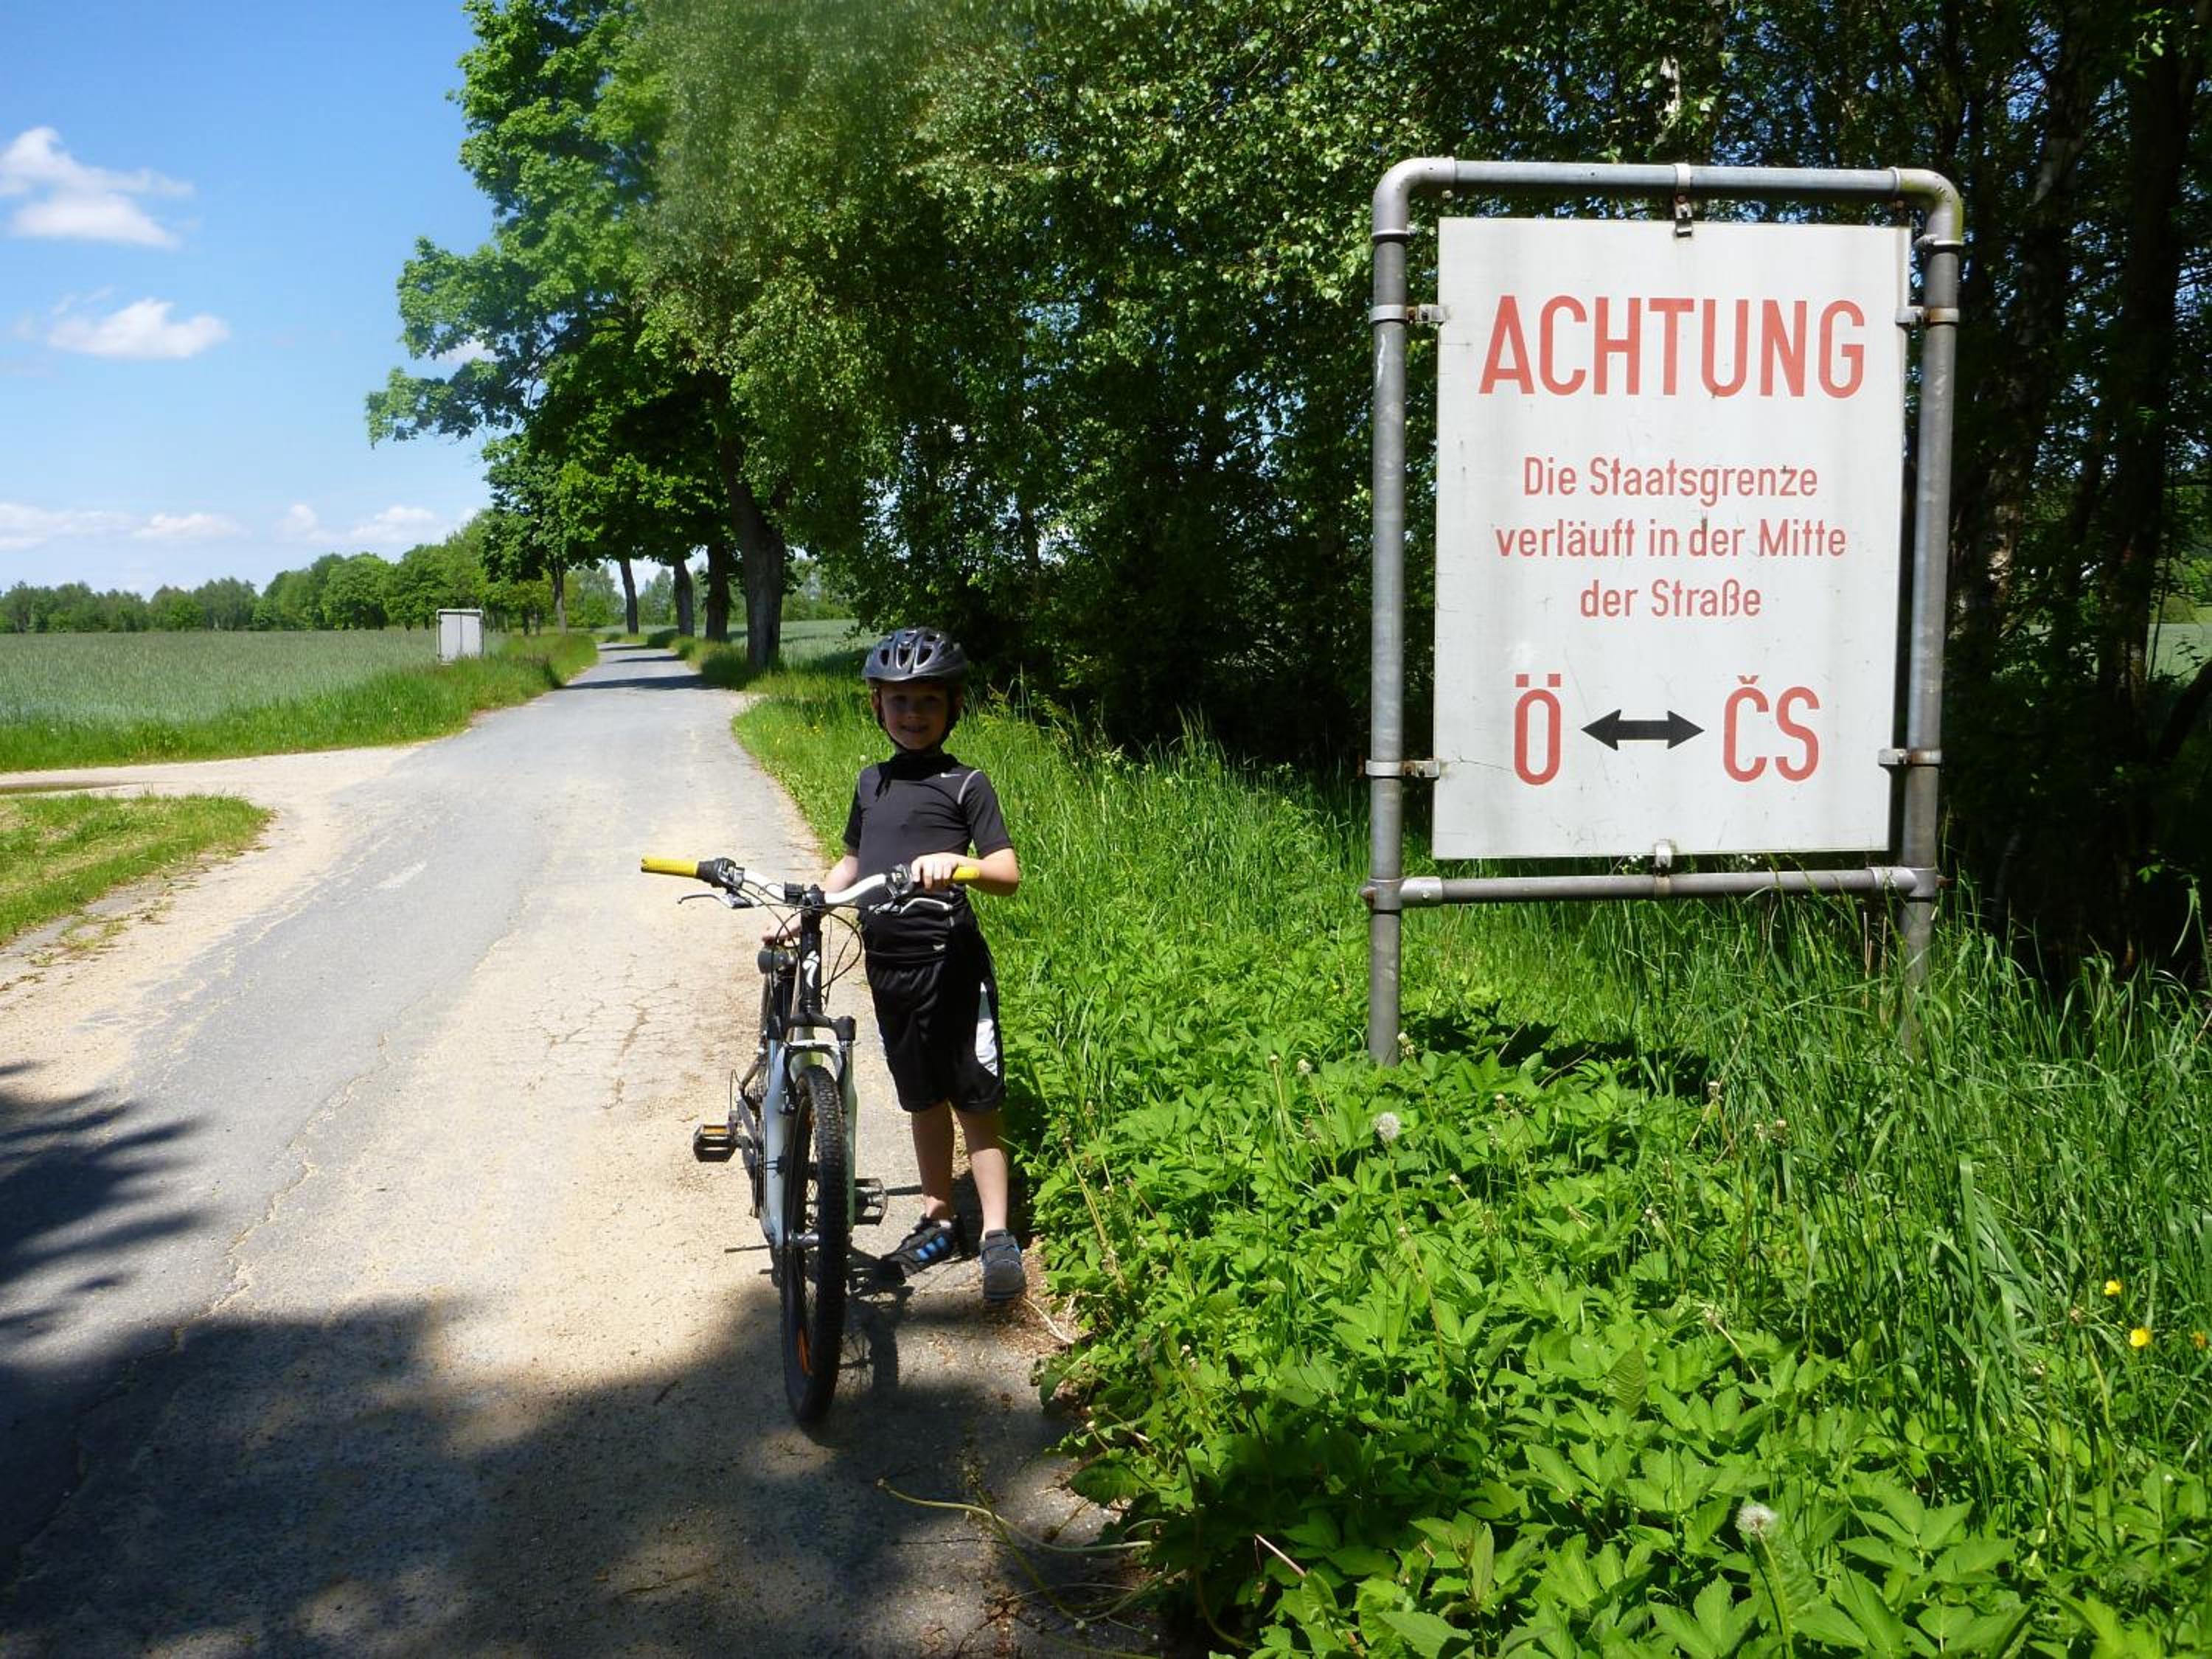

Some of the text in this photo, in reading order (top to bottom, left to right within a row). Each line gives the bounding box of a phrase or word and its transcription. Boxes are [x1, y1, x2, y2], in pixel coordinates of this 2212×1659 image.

[1478, 294, 1865, 399] ACHTUNG
[1523, 456, 1818, 507] Die Staatsgrenze
[1496, 518, 1846, 557] verläuft in der Mitte
[1579, 577, 1761, 618] der Straße
[1514, 673, 1821, 786] Ö ČS
